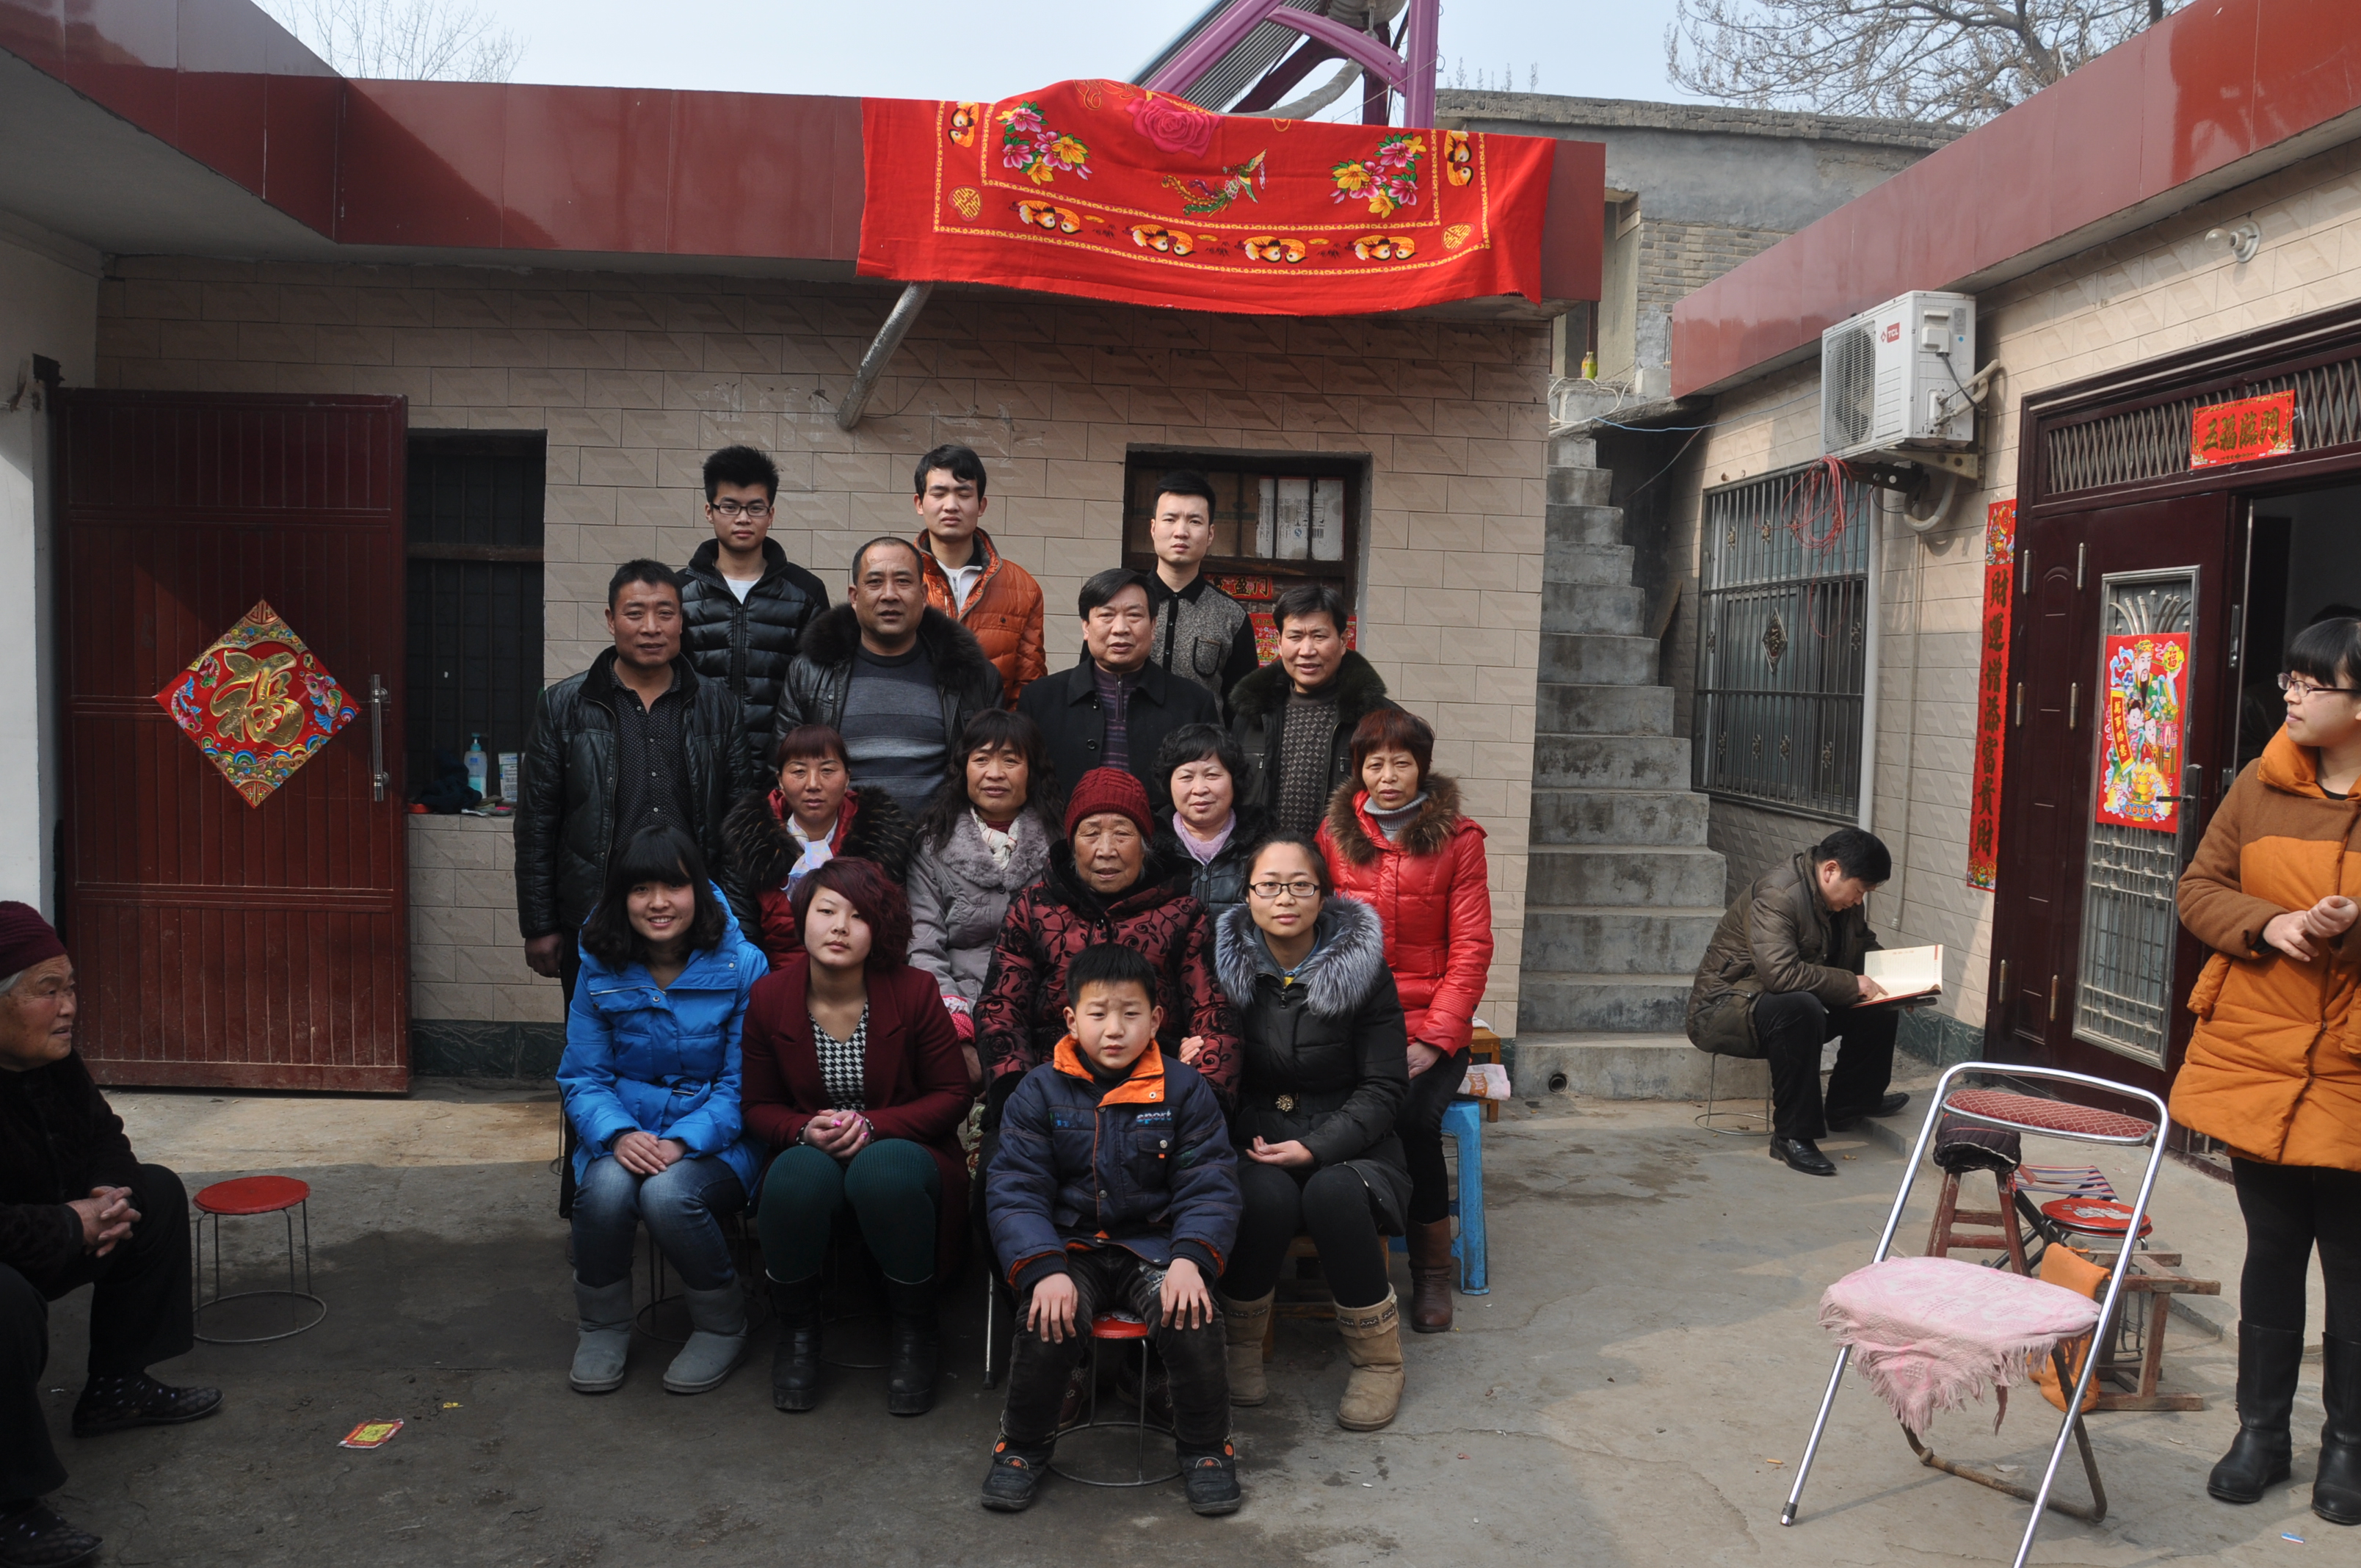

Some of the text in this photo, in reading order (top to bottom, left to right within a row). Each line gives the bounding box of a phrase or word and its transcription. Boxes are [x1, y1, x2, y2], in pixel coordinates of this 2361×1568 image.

[1887, 330, 1899, 338] TCL
[2203, 407, 2280, 451] 五福臨門
[1258, 647, 1275, 658] 春
[210, 650, 305, 747] 福
[1136, 1108, 1172, 1124] sport
